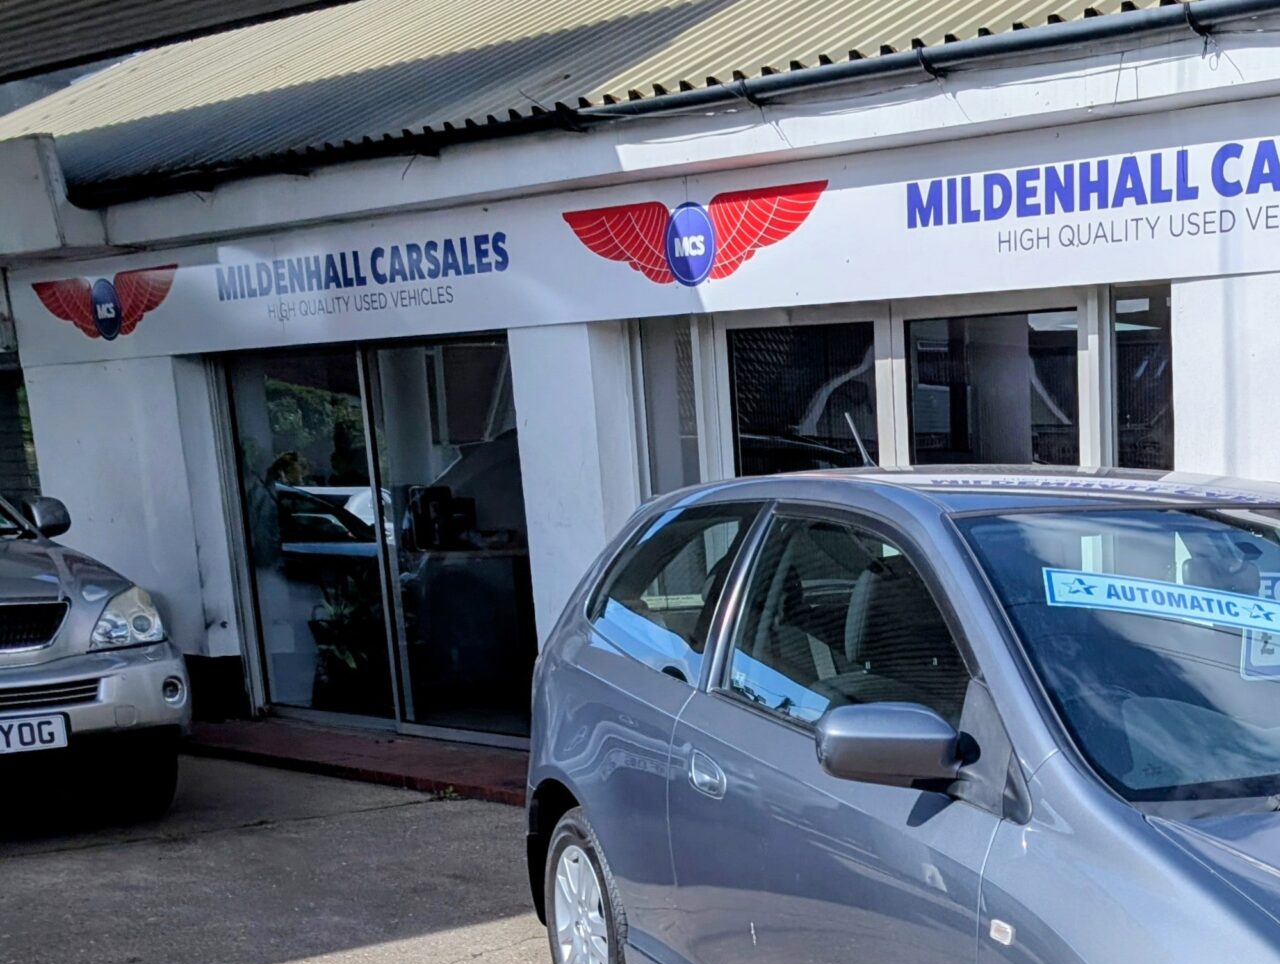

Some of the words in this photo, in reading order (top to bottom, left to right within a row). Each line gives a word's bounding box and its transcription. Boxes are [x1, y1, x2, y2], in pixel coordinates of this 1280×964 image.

[906, 146, 1200, 229] MILDENHALL
[674, 235, 705, 257] MCS
[998, 228, 1050, 253] HIGH
[1058, 215, 1160, 249] QUALITY
[1169, 210, 1236, 237] USED
[216, 250, 367, 301] MILDENHALL
[370, 231, 509, 285] CARSALES
[96, 303, 115, 319] MCS
[267, 302, 296, 321] HIGH
[299, 294, 350, 316] QUALITY
[355, 292, 387, 312] USED
[390, 285, 454, 308] VEHICLES
[1106, 583, 1240, 618] AUTOMATIC
[0, 720, 55, 748] YOG
